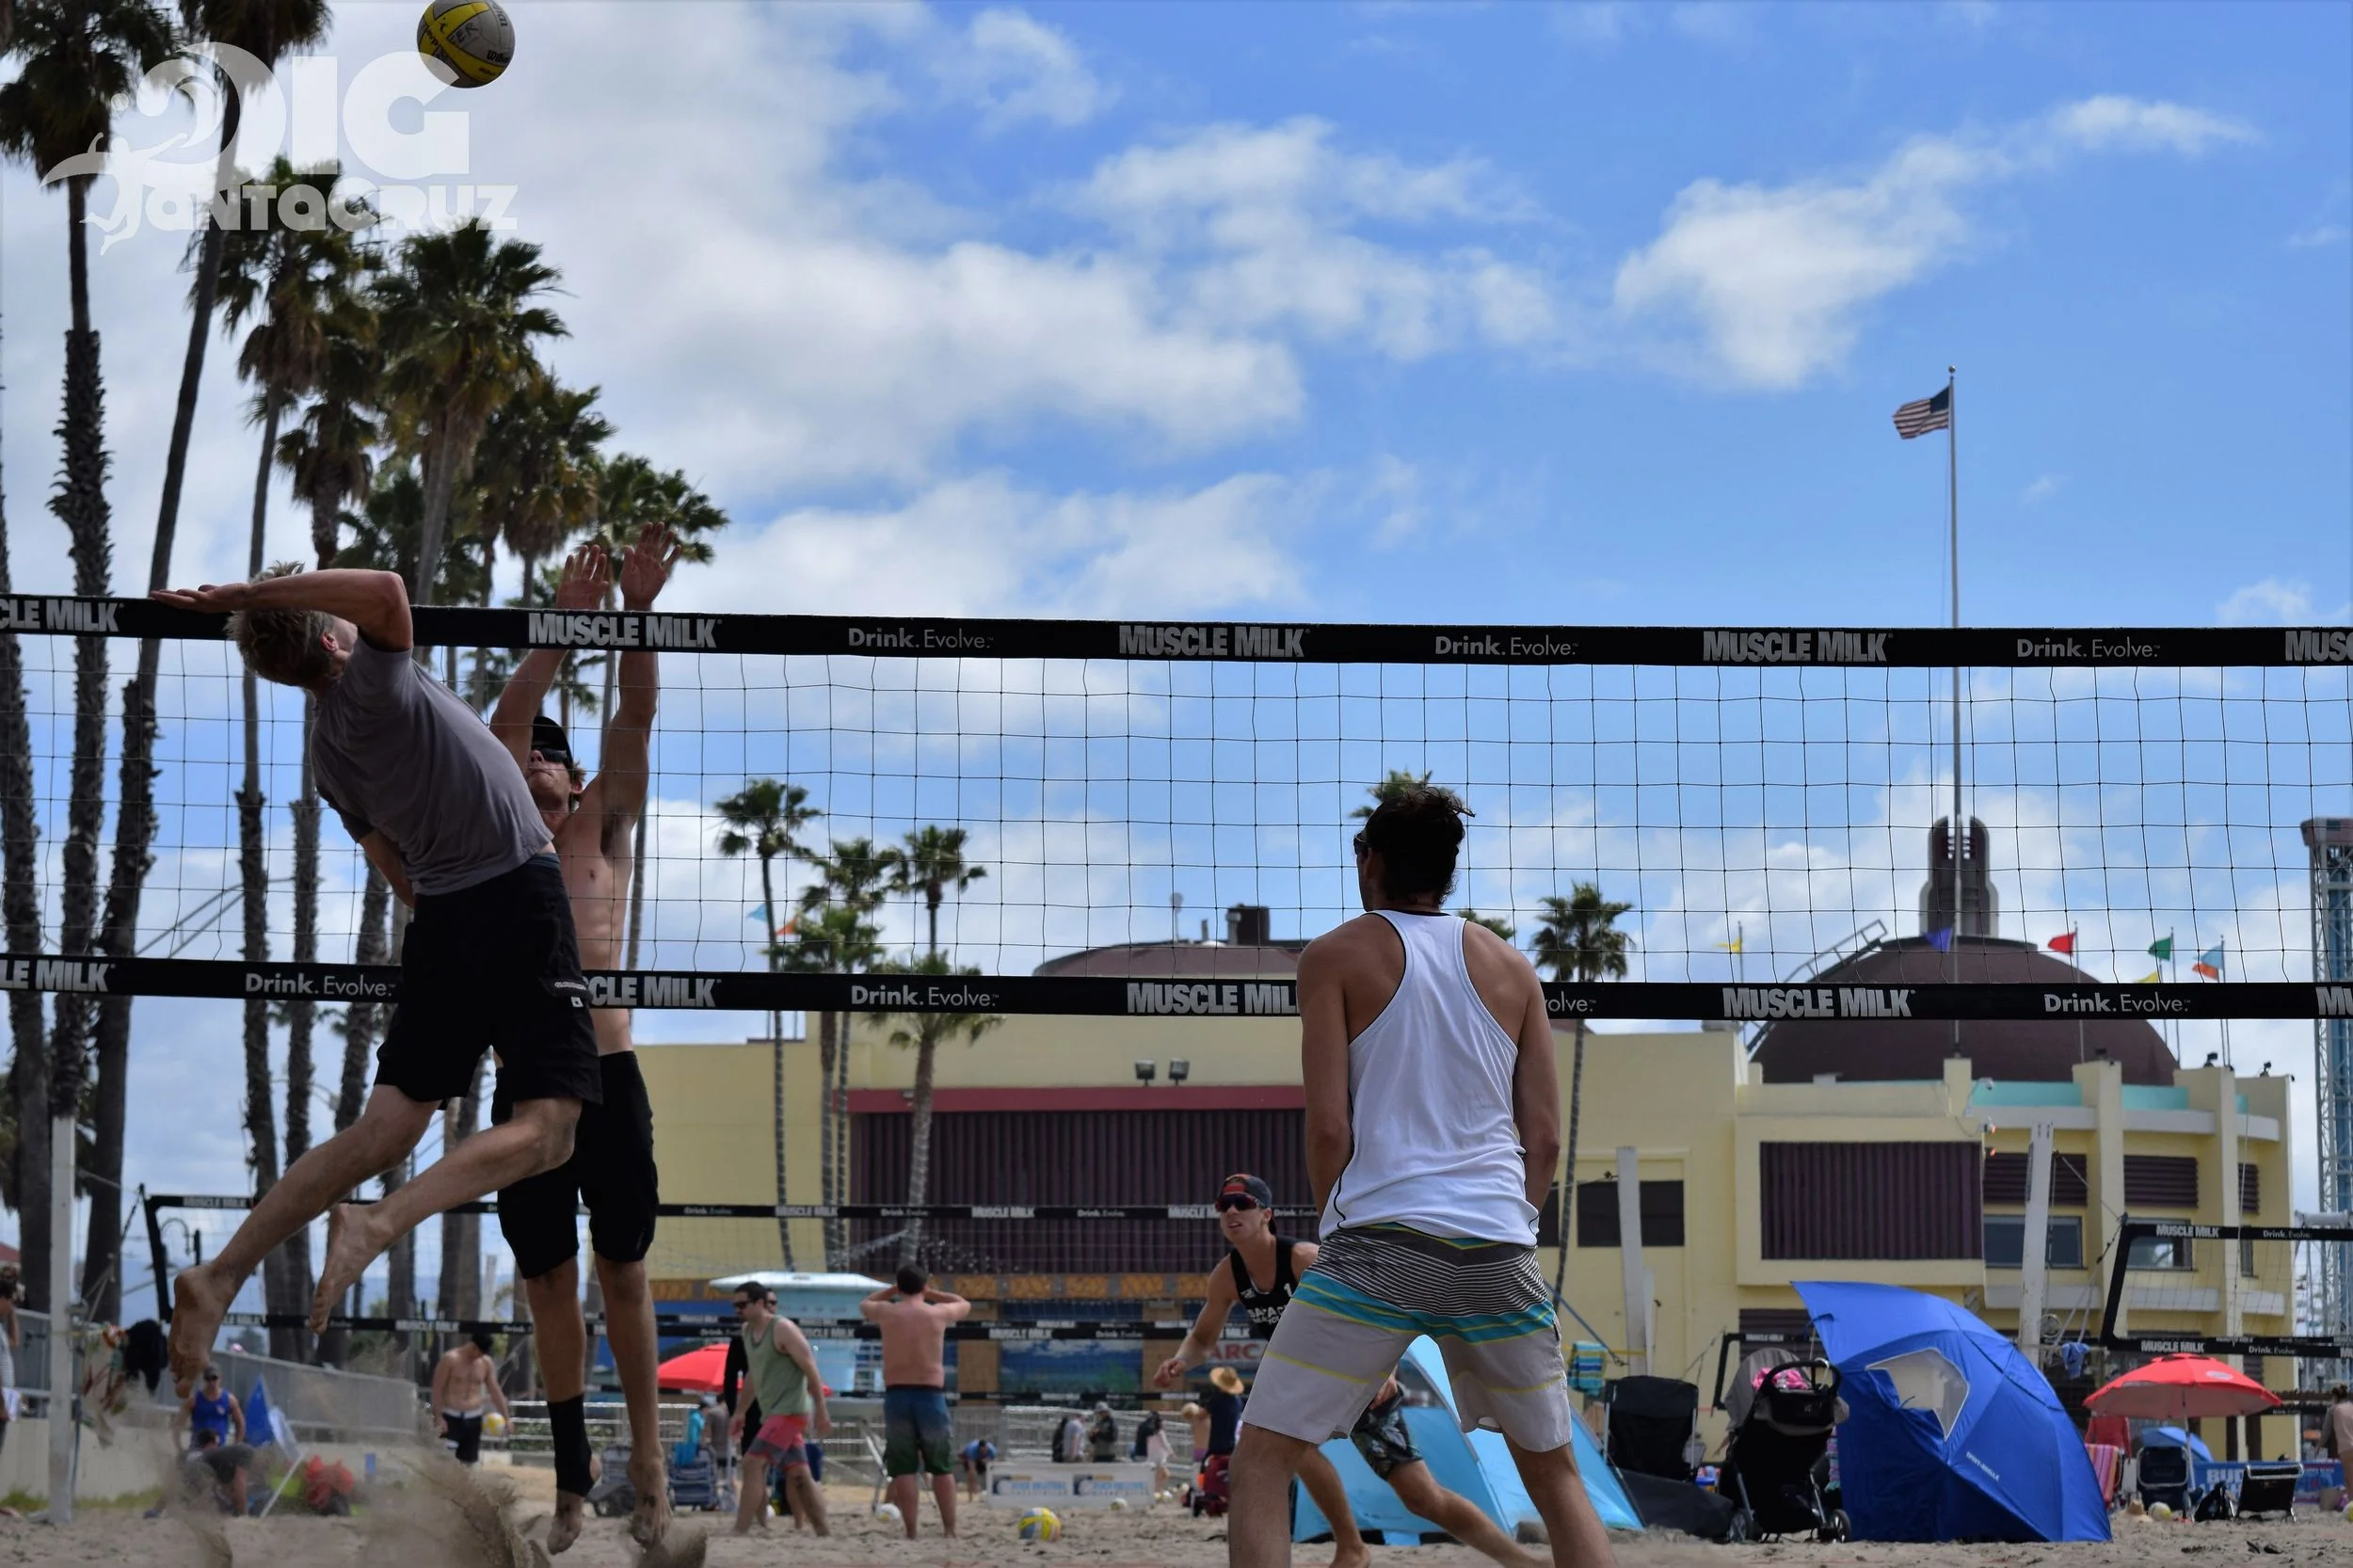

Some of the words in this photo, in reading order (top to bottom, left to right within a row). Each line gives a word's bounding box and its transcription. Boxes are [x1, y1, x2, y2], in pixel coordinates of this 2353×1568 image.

[46, 599, 120, 632] MILK
[528, 613, 640, 647] MUSCLE
[646, 616, 717, 648] MILK
[848, 628, 920, 648] Drink.
[1119, 625, 1228, 656] MUSCLE
[1234, 626, 1305, 658] MILK
[1435, 634, 1506, 656] Drink.
[1703, 631, 1811, 662] MUSCLE
[1817, 632, 1887, 663] MILK
[2017, 637, 2088, 658] Drink.
[36, 960, 108, 992] MILK
[246, 972, 319, 994] Drink.
[644, 976, 716, 1007] MILK
[852, 985, 924, 1005] Drink.
[1128, 983, 1238, 1014] MUSCLE
[1244, 984, 1300, 1014] MIL
[1722, 987, 1834, 1018] MUSCLE
[1838, 987, 1912, 1017] MILK
[2044, 992, 2117, 1013] Drink.
